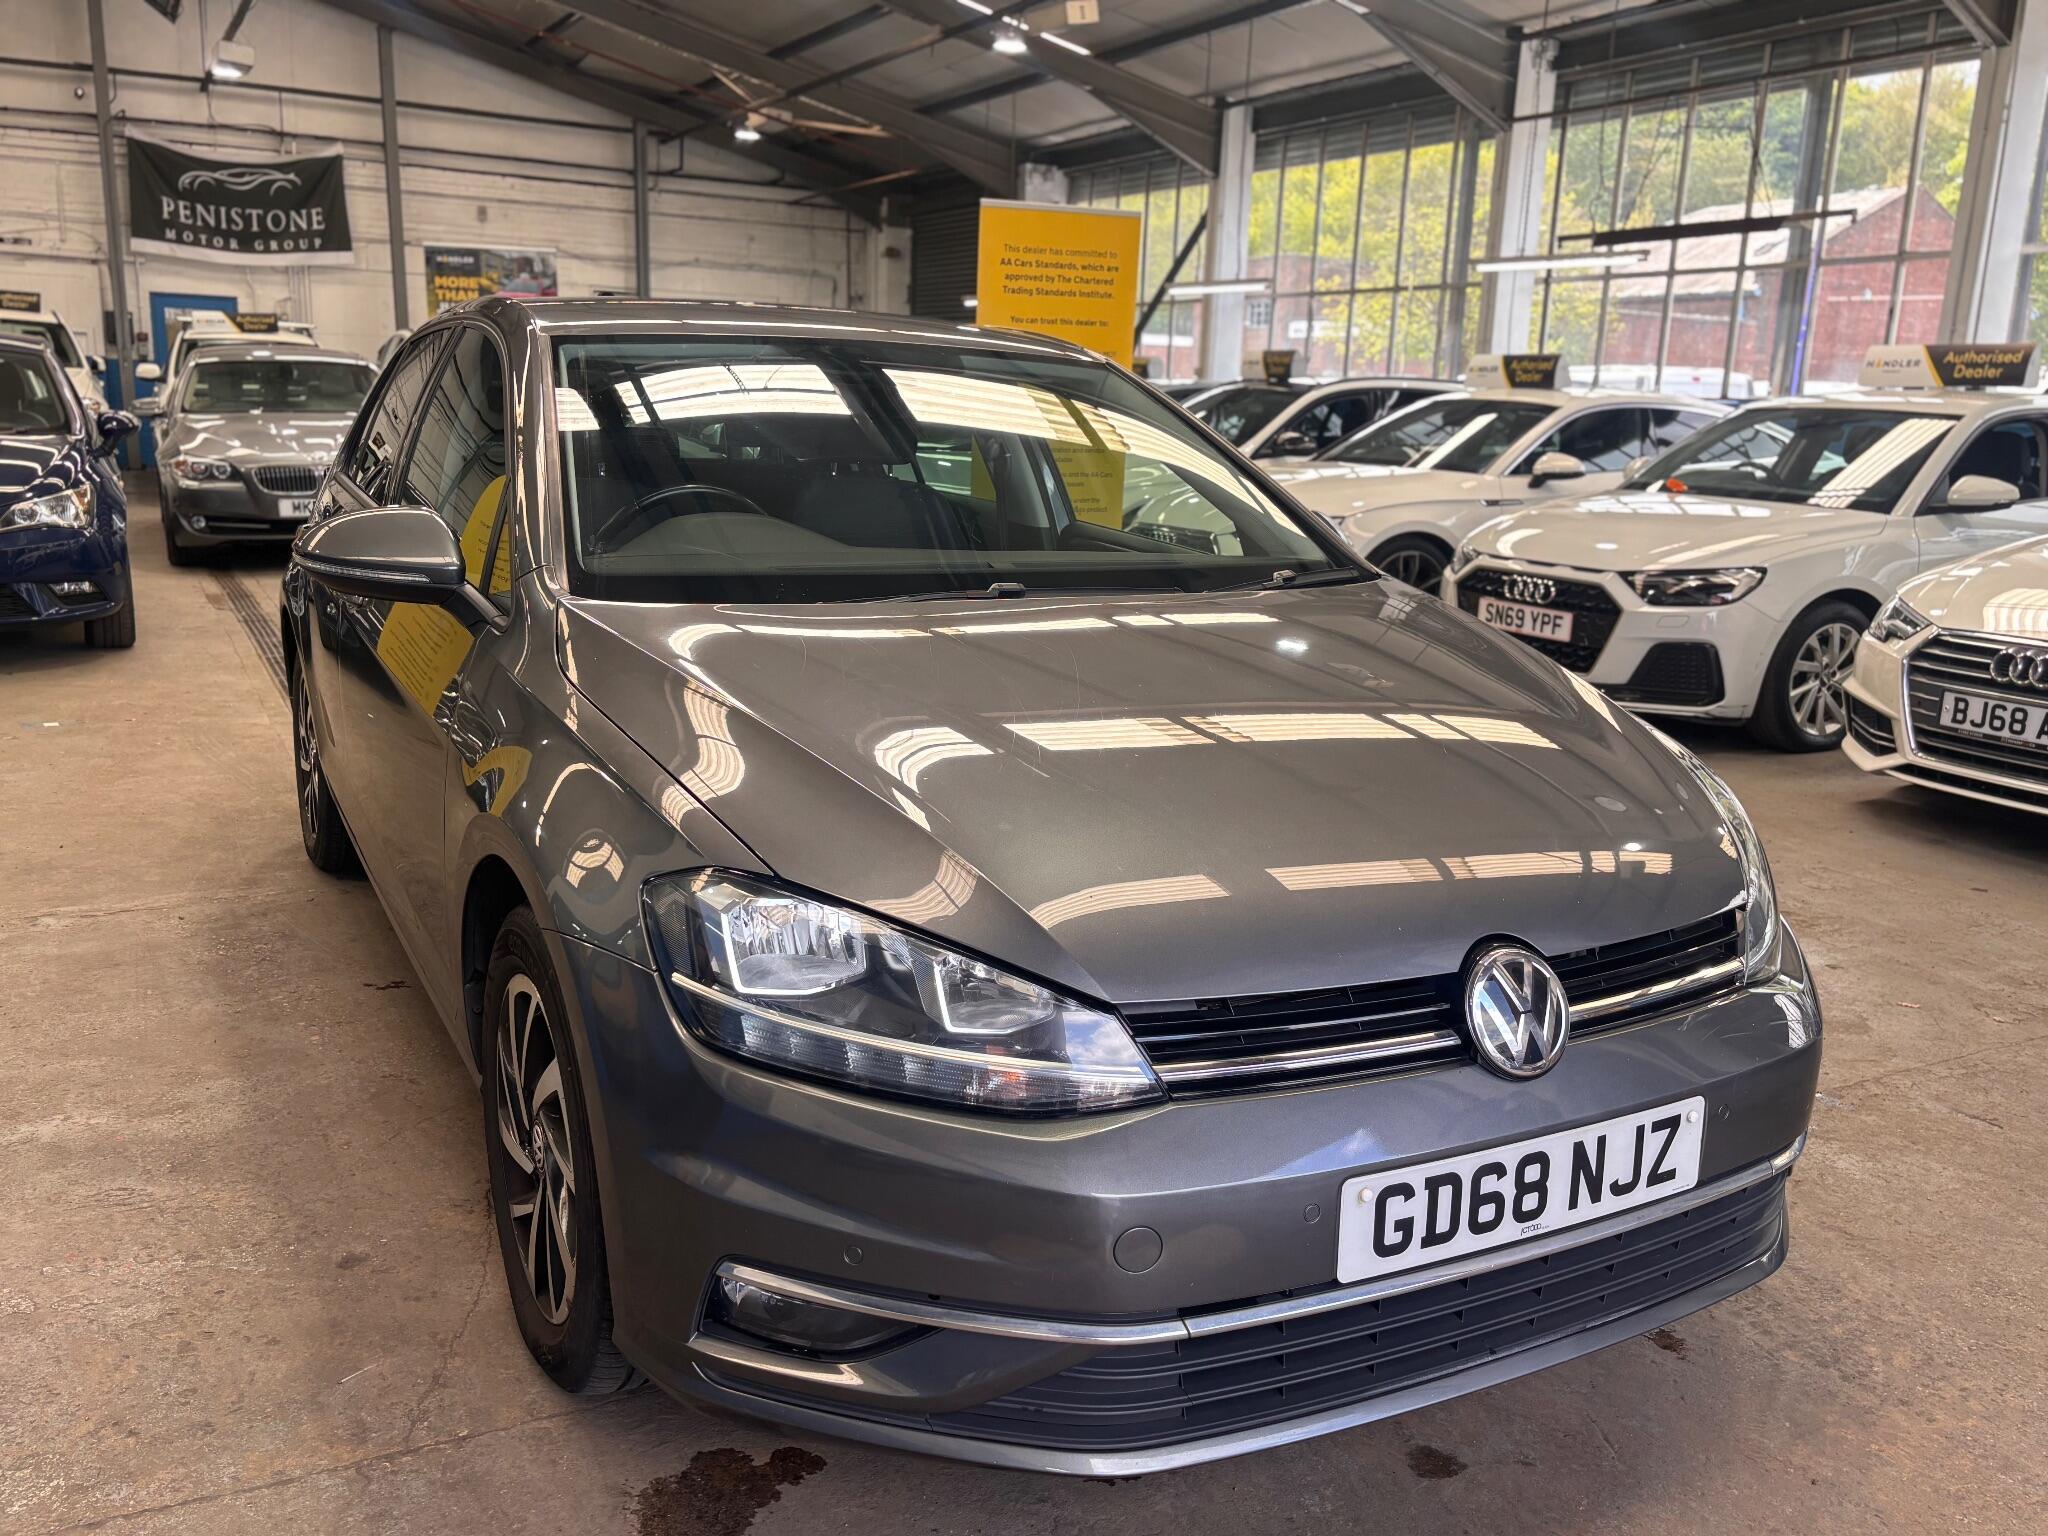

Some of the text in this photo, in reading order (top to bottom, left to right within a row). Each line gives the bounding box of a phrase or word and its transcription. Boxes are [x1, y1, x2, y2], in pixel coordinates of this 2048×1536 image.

[160, 195, 327, 232] PENISTONE
[165, 228, 323, 251] MOTOR GROUP
[1004, 243, 1118, 259] This dealer has committed to
[1000, 257, 1120, 273] AA Cars Standards, which are
[434, 275, 479, 290] MORE
[1004, 272, 1115, 286] approved by The Chartered
[435, 288, 480, 302] THAN
[1003, 285, 1034, 297] Trading
[1035, 287, 1077, 298] Standards
[1010, 315, 1025, 325] You
[1025, 317, 1039, 325] can
[1040, 316, 1059, 326] trust
[1059, 318, 1074, 326] this
[1075, 318, 1097, 328] dealer
[1943, 349, 2025, 365] Authorised
[1953, 364, 2004, 379] Dealer
[1485, 602, 1564, 636] SN69 YPF
[1950, 696, 2029, 736] BJ68
[1372, 1113, 1682, 1259] GD68 NJZ
